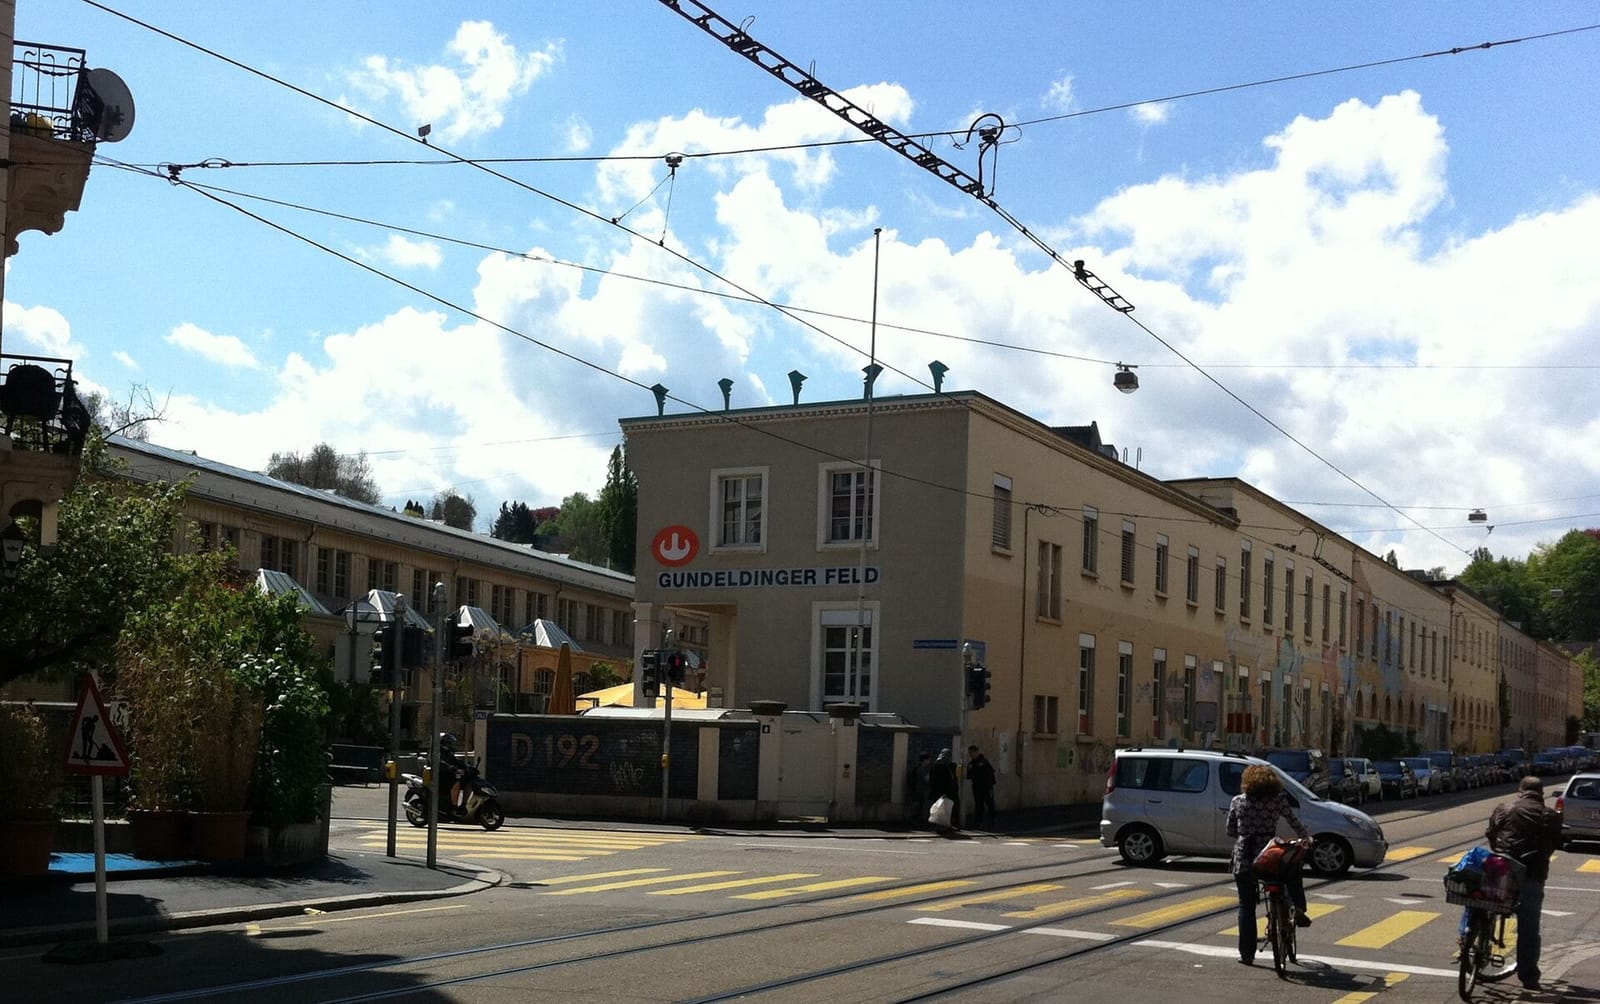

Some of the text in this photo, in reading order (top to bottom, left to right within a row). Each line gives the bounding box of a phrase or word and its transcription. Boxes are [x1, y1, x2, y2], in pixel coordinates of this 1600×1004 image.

[659, 567, 878, 588] GUNDELDINGER FELD
[511, 733, 534, 767] D
[544, 734, 600, 769] 192
